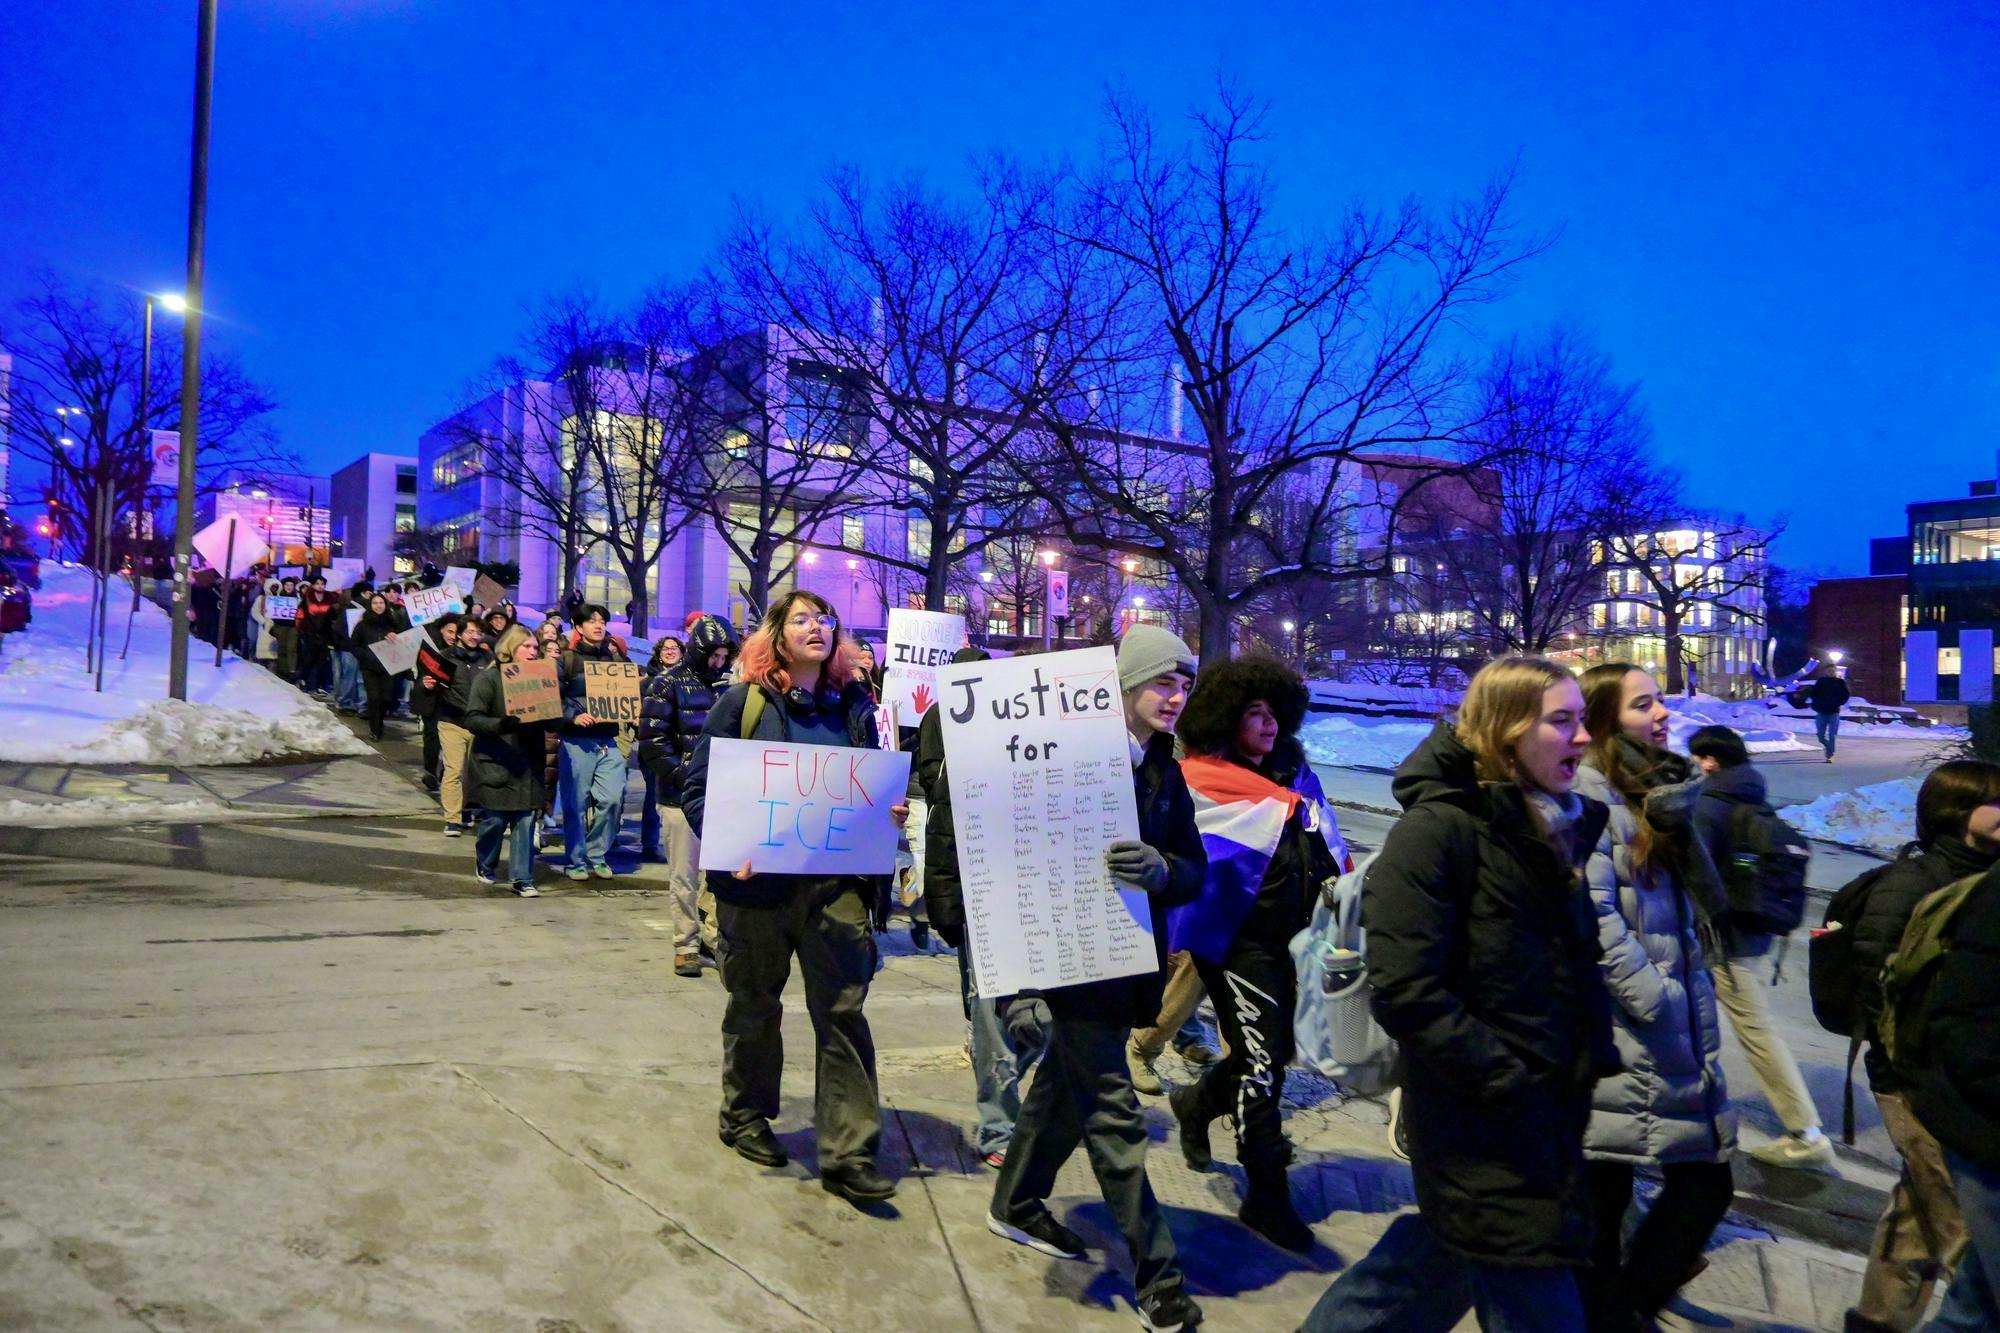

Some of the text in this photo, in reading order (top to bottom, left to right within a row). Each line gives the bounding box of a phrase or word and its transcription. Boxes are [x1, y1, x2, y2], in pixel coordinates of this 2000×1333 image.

[412, 586, 454, 609] FUCK
[272, 606, 297, 618] ICE
[421, 603, 447, 619] ICE
[893, 620, 918, 641] NO
[920, 620, 952, 643] ONE
[894, 643, 956, 667] ILLEGA
[504, 664, 520, 680] NO
[586, 662, 636, 678] ICE
[606, 680, 618, 691] is
[949, 667, 1110, 724] Justice
[1005, 734, 1058, 762] for
[763, 749, 874, 808] FUCK
[758, 800, 854, 851] ICE
